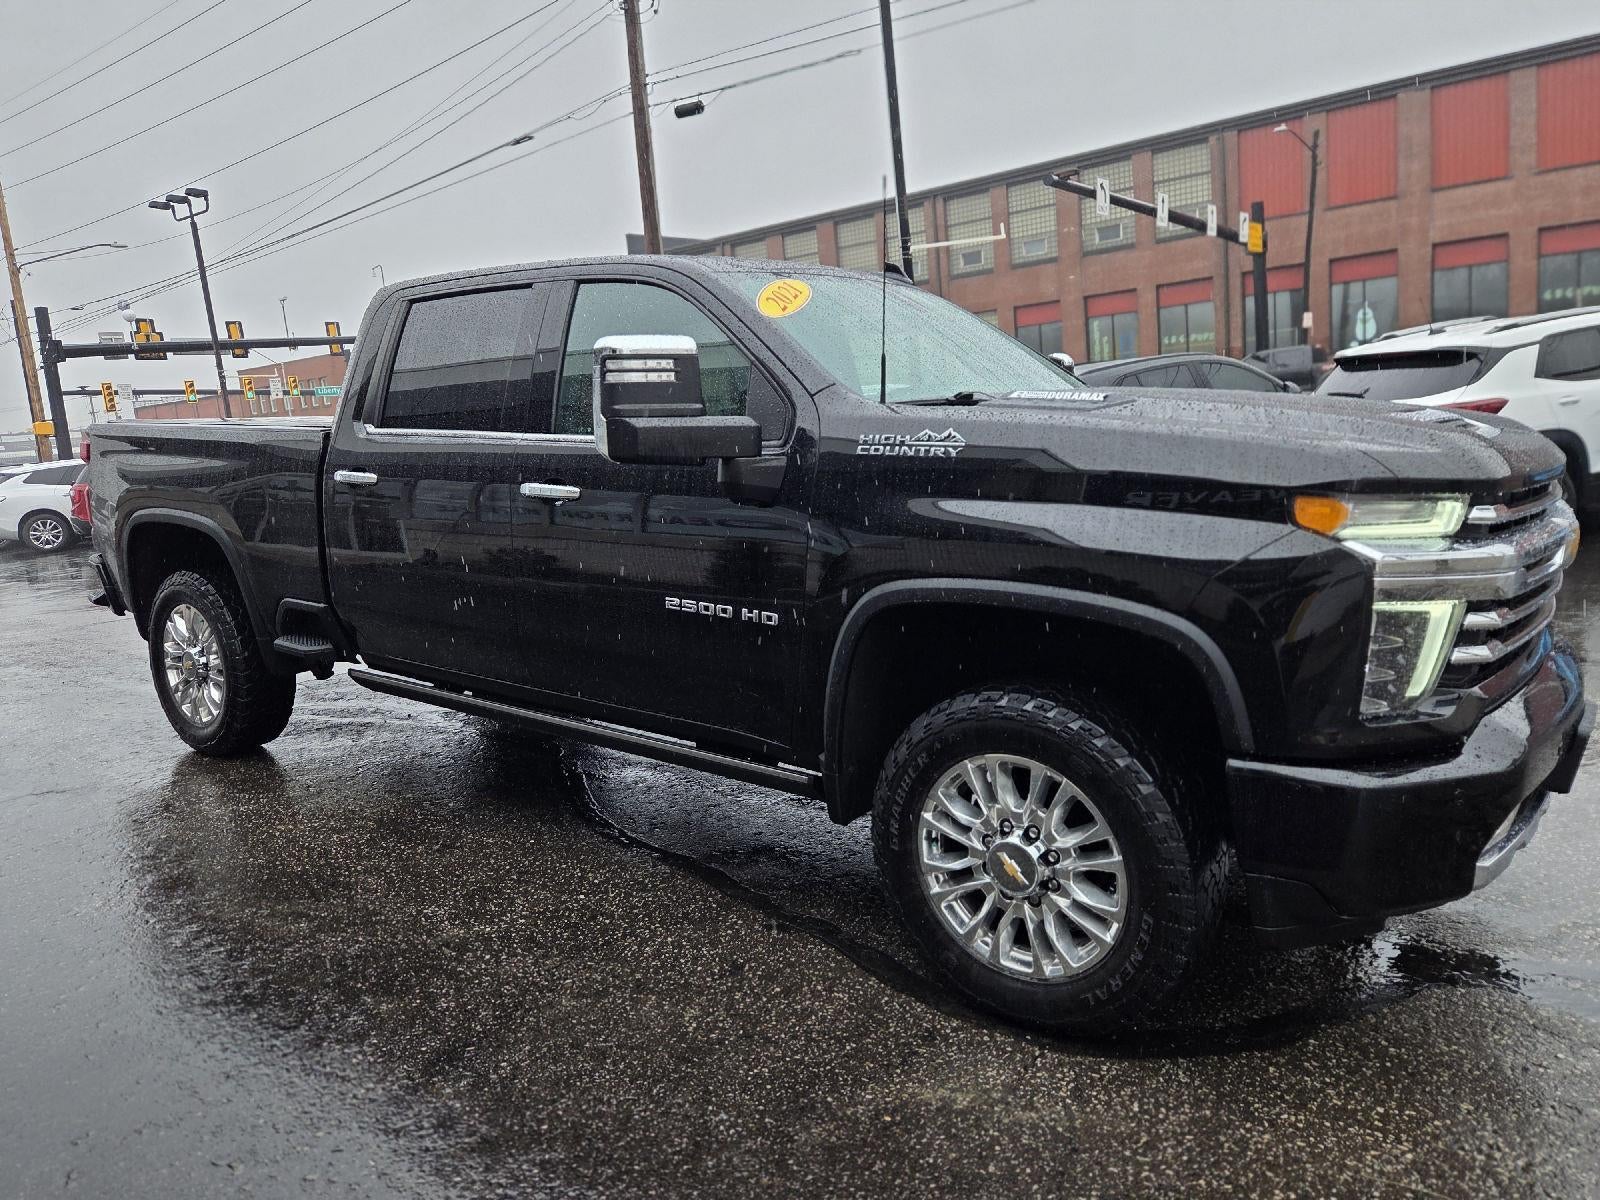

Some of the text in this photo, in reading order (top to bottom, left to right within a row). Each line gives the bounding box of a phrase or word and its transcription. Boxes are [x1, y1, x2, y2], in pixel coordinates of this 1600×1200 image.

[766, 282, 802, 312] 2021
[1048, 391, 1106, 401] DURAMAX
[856, 445, 964, 457] COUNTRY
[859, 434, 911, 445] HIGH
[665, 597, 779, 626] 2500 HD
[889, 749, 930, 850] GRABBER
[1080, 911, 1153, 1008] GENERAL
